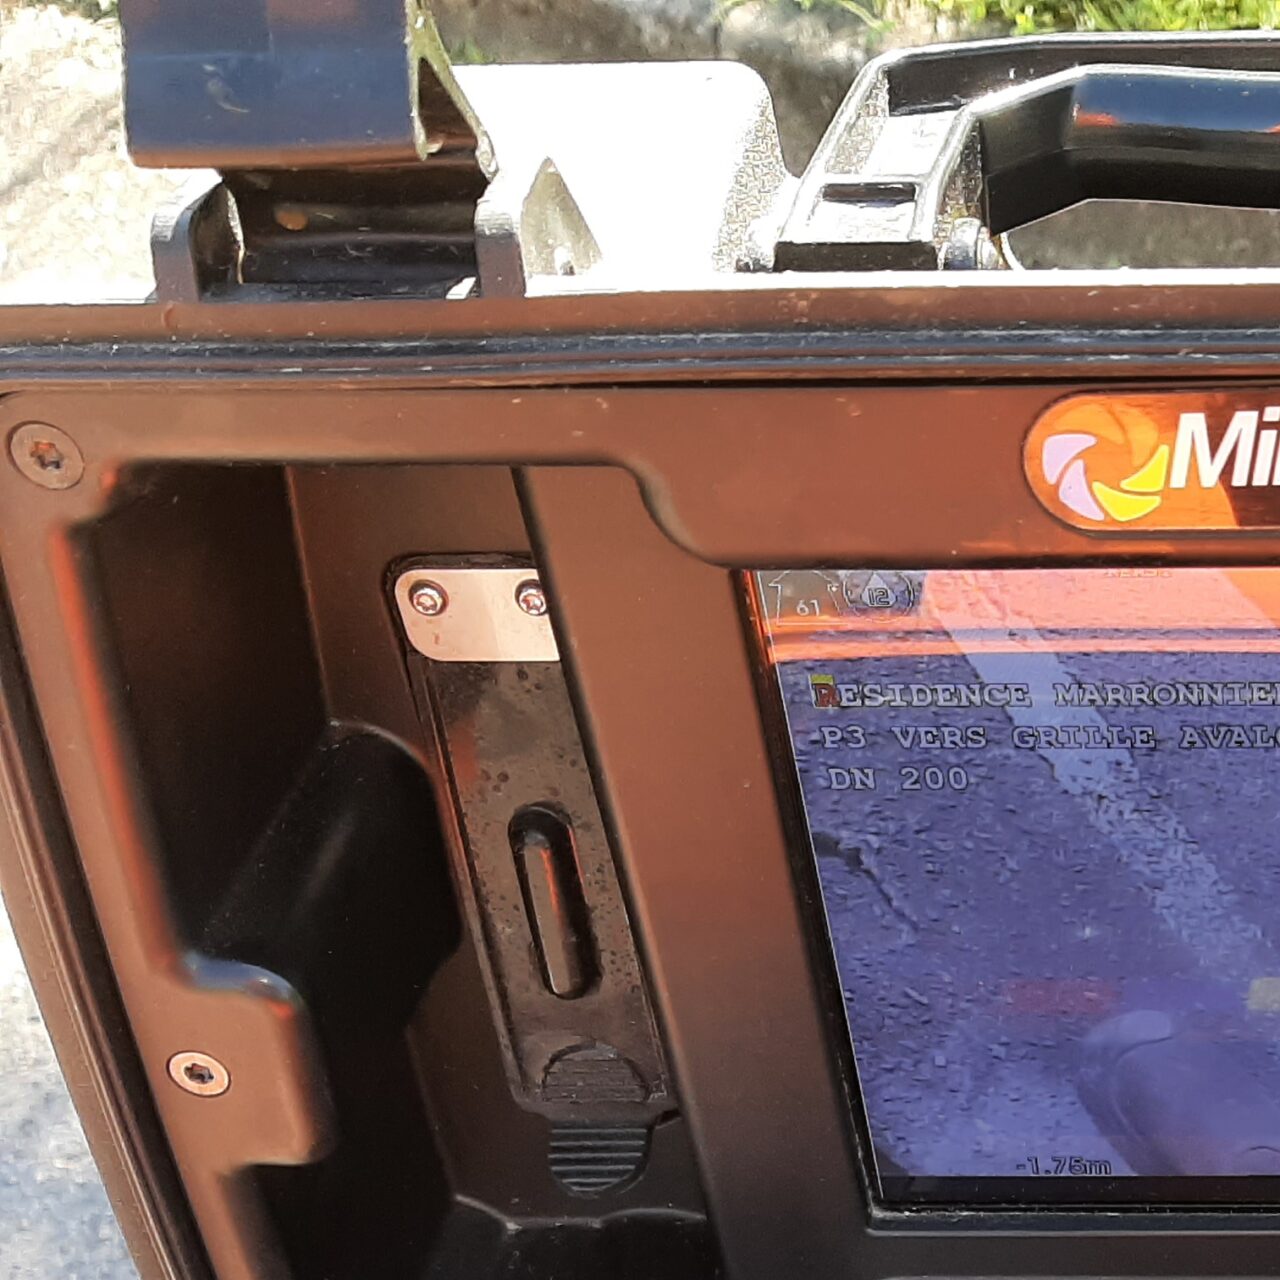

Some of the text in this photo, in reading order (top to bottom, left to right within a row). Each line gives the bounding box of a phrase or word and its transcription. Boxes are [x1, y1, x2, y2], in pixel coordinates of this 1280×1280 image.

[868, 588, 890, 606] 12
[812, 682, 1032, 707] RESIDENCE
[821, 726, 866, 749] P3
[891, 726, 987, 749] VERS
[1011, 726, 1156, 750] GRILLE
[828, 767, 969, 790] DN 200
